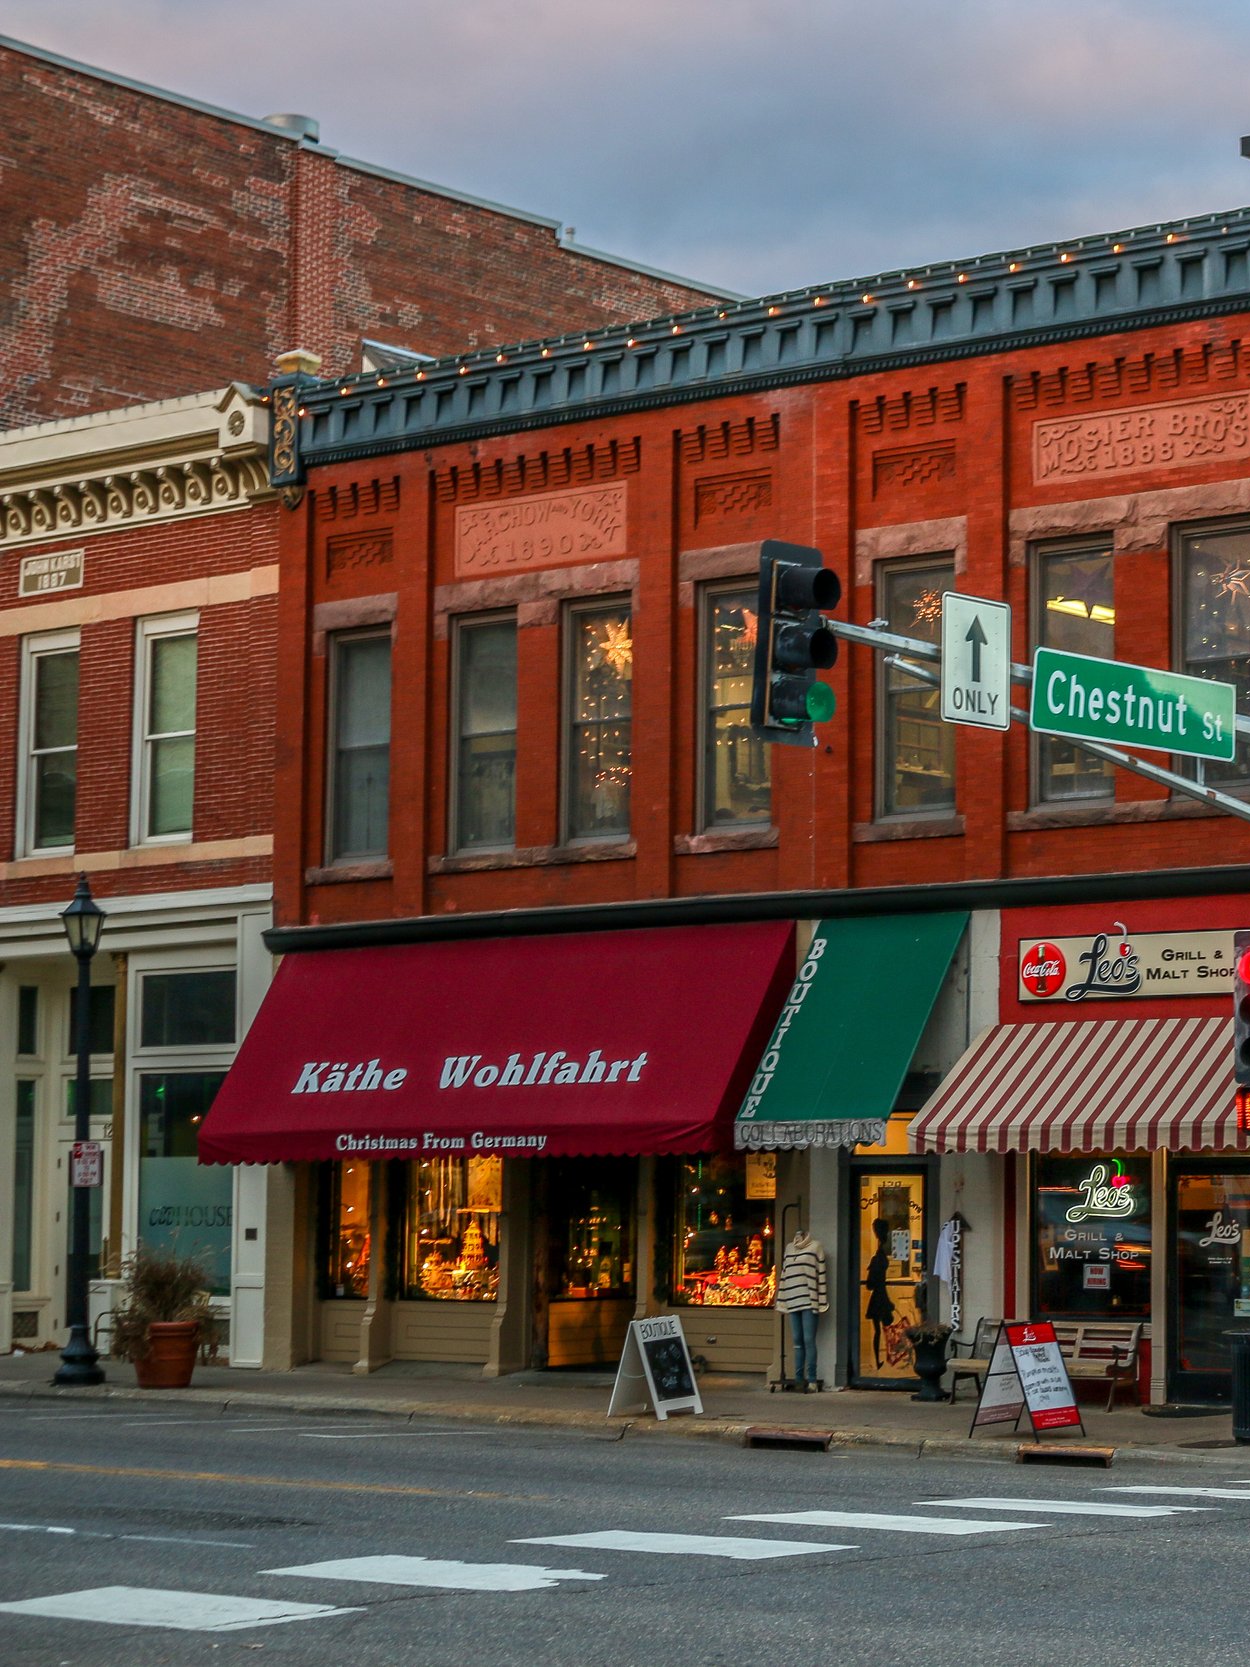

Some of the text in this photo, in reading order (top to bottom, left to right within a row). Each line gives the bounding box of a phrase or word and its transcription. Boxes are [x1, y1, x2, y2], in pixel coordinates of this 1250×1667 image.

[1103, 440, 1174, 470] 1888
[569, 498, 622, 542] YORK
[505, 535, 574, 563] 1890
[952, 686, 999, 717] ONLY
[1046, 669, 1223, 742] Chestnut St
[1161, 949, 1223, 962] GRILL &
[1146, 967, 1189, 980] MALT
[741, 938, 828, 1118] BOUTIQUE
[291, 1049, 648, 1094] Käthe Wohlfahrt
[335, 1131, 547, 1151] Christmas From Germany
[741, 1122, 883, 1143] COLLABORATIONS
[1064, 1229, 1124, 1241] GRILL &
[1049, 1247, 1139, 1260] MALT SHOP
[950, 1221, 961, 1332] UPSTAIRS
[640, 1321, 678, 1340] BOUTIQUE
